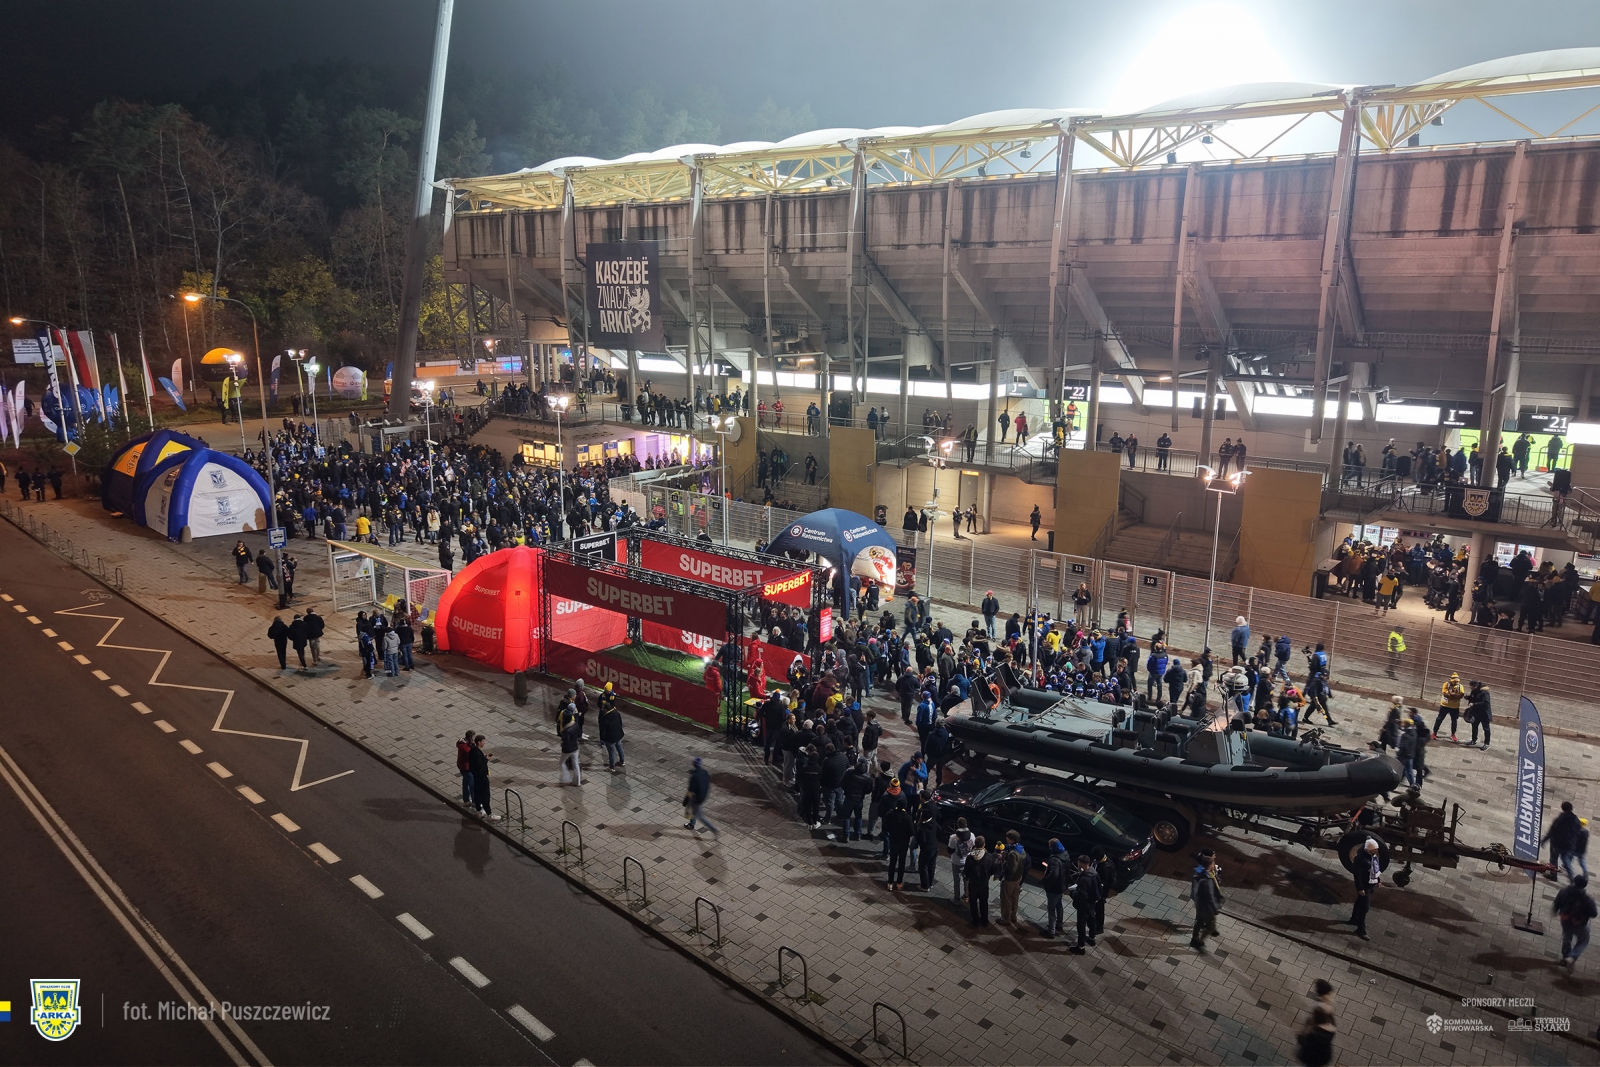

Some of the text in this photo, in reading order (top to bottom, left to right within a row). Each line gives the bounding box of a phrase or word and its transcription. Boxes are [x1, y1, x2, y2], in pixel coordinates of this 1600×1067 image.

[595, 256, 649, 285] KASZËBË
[600, 310, 633, 334] ARKA
[1072, 386, 1085, 397] 22
[1549, 416, 1568, 429] 21
[579, 537, 610, 550] SUPERBET
[801, 532, 833, 543] Ratownictwa
[803, 527, 826, 536] Centrum
[679, 553, 763, 588] SUPERBET
[474, 584, 500, 596] SUPERBET
[763, 571, 811, 596] SUPERBET
[586, 576, 674, 616] SUPERBET
[451, 615, 503, 640] SUPERBET
[585, 658, 672, 701] SUPERBET
